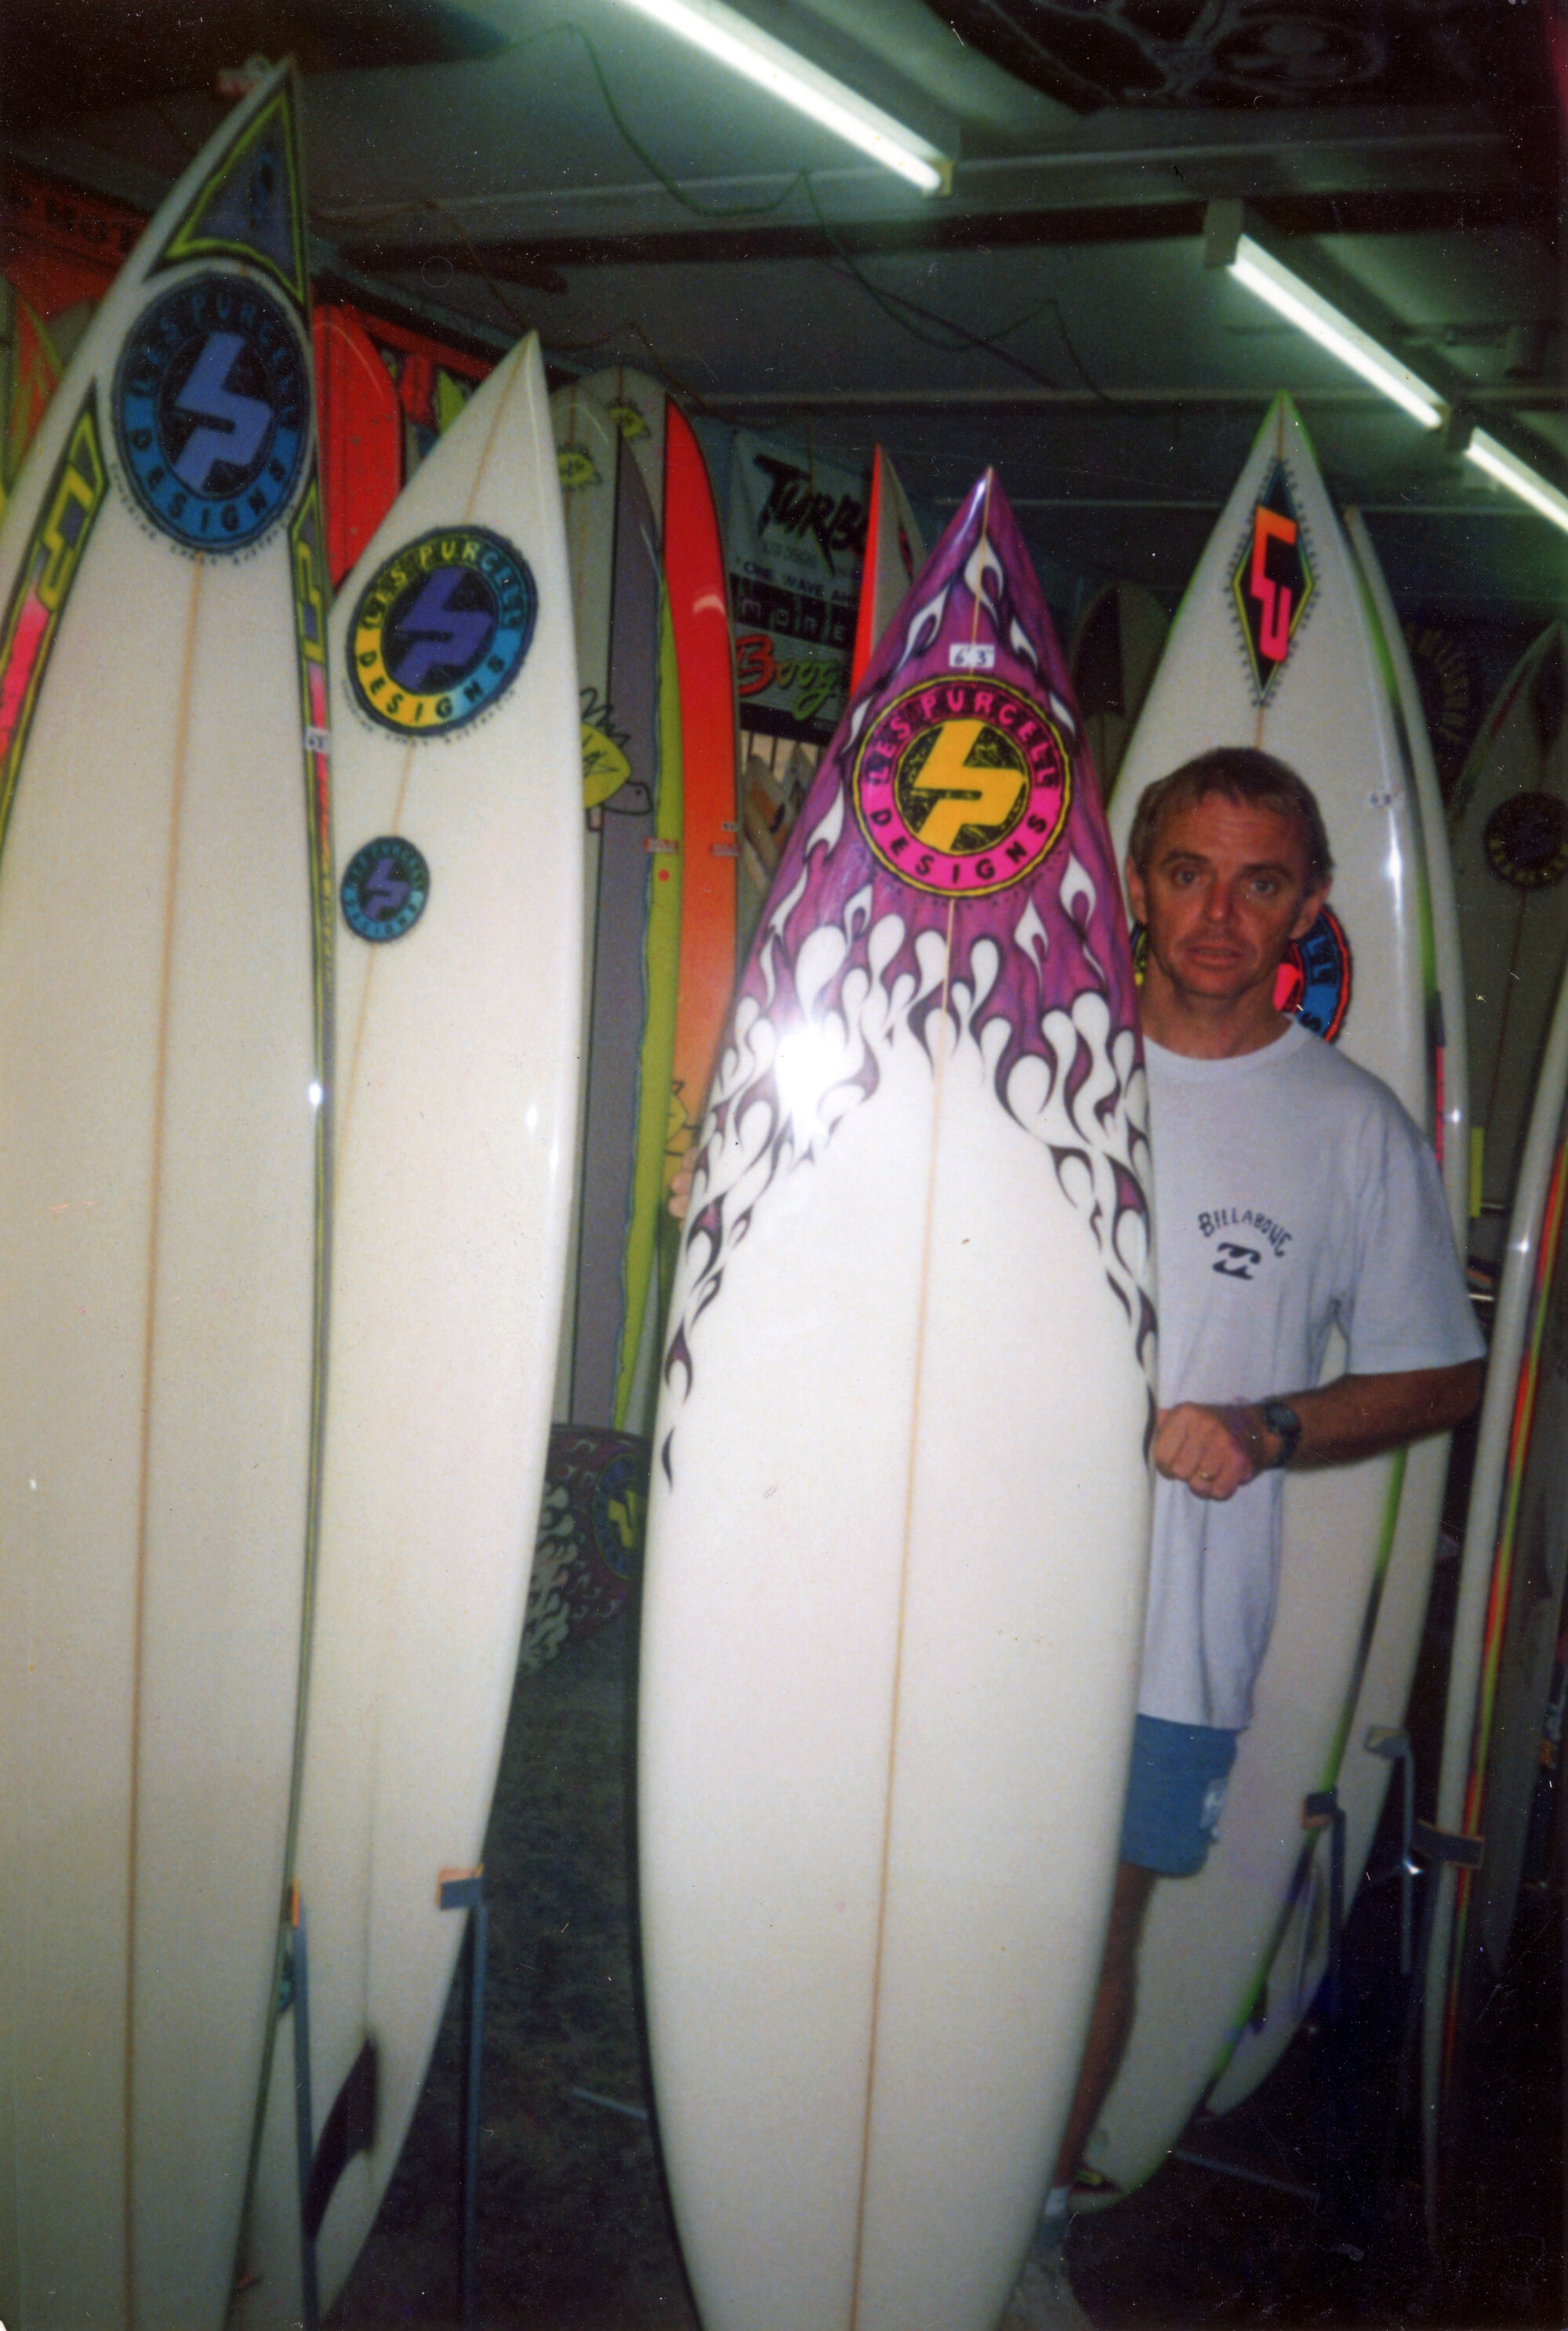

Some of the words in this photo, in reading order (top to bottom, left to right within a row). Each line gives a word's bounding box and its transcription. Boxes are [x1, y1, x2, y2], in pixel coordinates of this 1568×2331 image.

[131, 428, 285, 533] DESIGNS
[359, 650, 506, 723] DESIGNS
[868, 716, 910, 782] LES
[920, 688, 1057, 783] PURCELL
[870, 807, 1047, 884] DESIGNS
